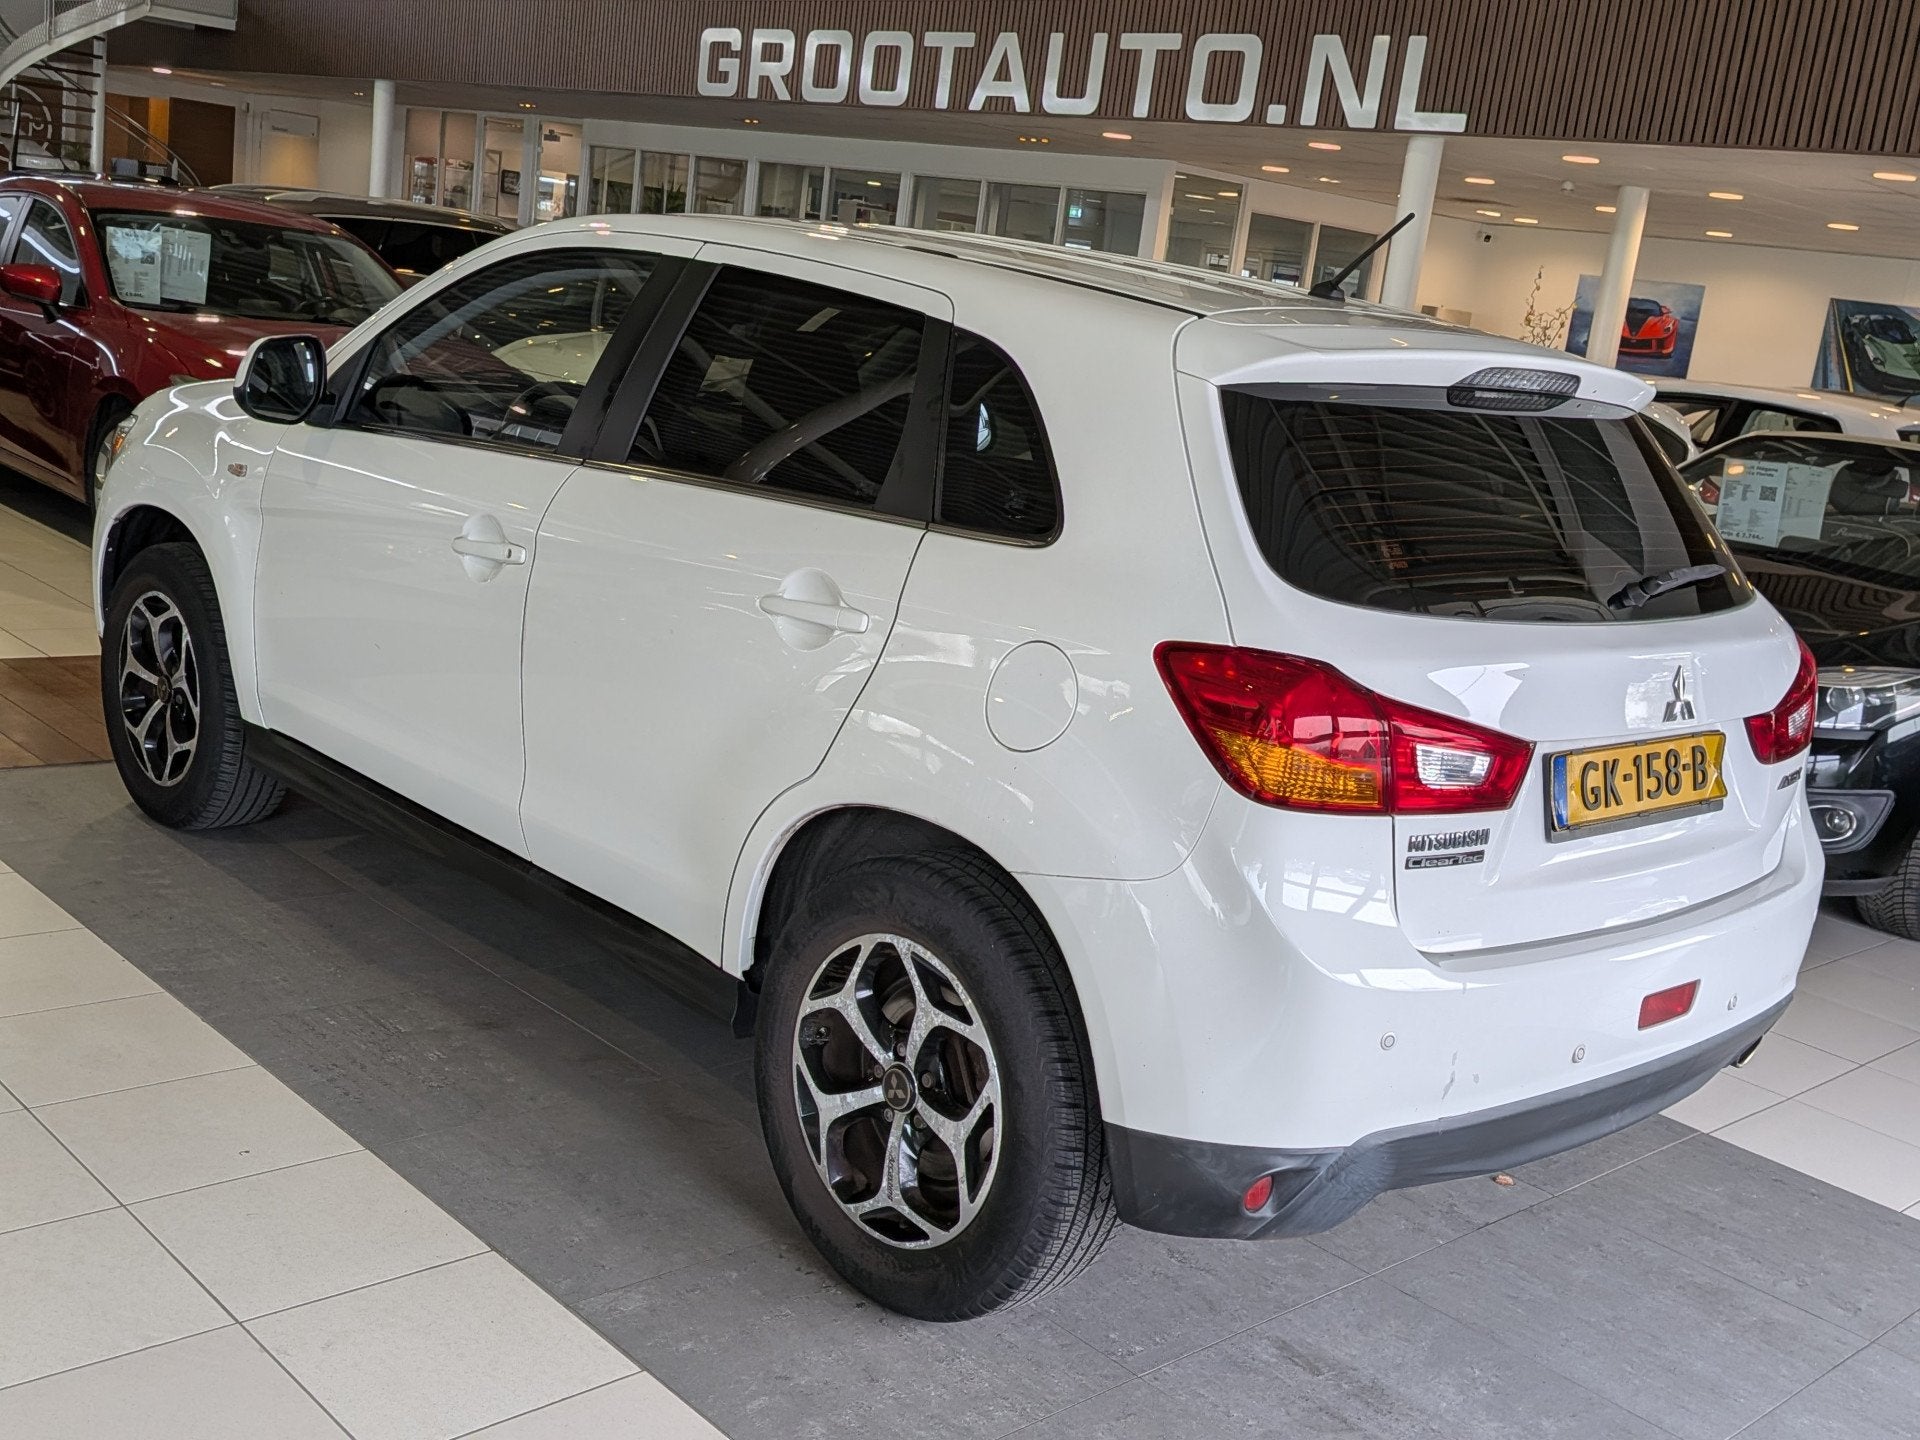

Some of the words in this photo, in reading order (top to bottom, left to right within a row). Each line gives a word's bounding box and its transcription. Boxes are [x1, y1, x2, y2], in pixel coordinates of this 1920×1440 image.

[697, 27, 1468, 132] GROOTAUTO.NL
[1580, 745, 1708, 811] GK-158-B
[1407, 828, 1491, 853] MITSUBISHI
[1408, 854, 1485, 868] ClearTec
